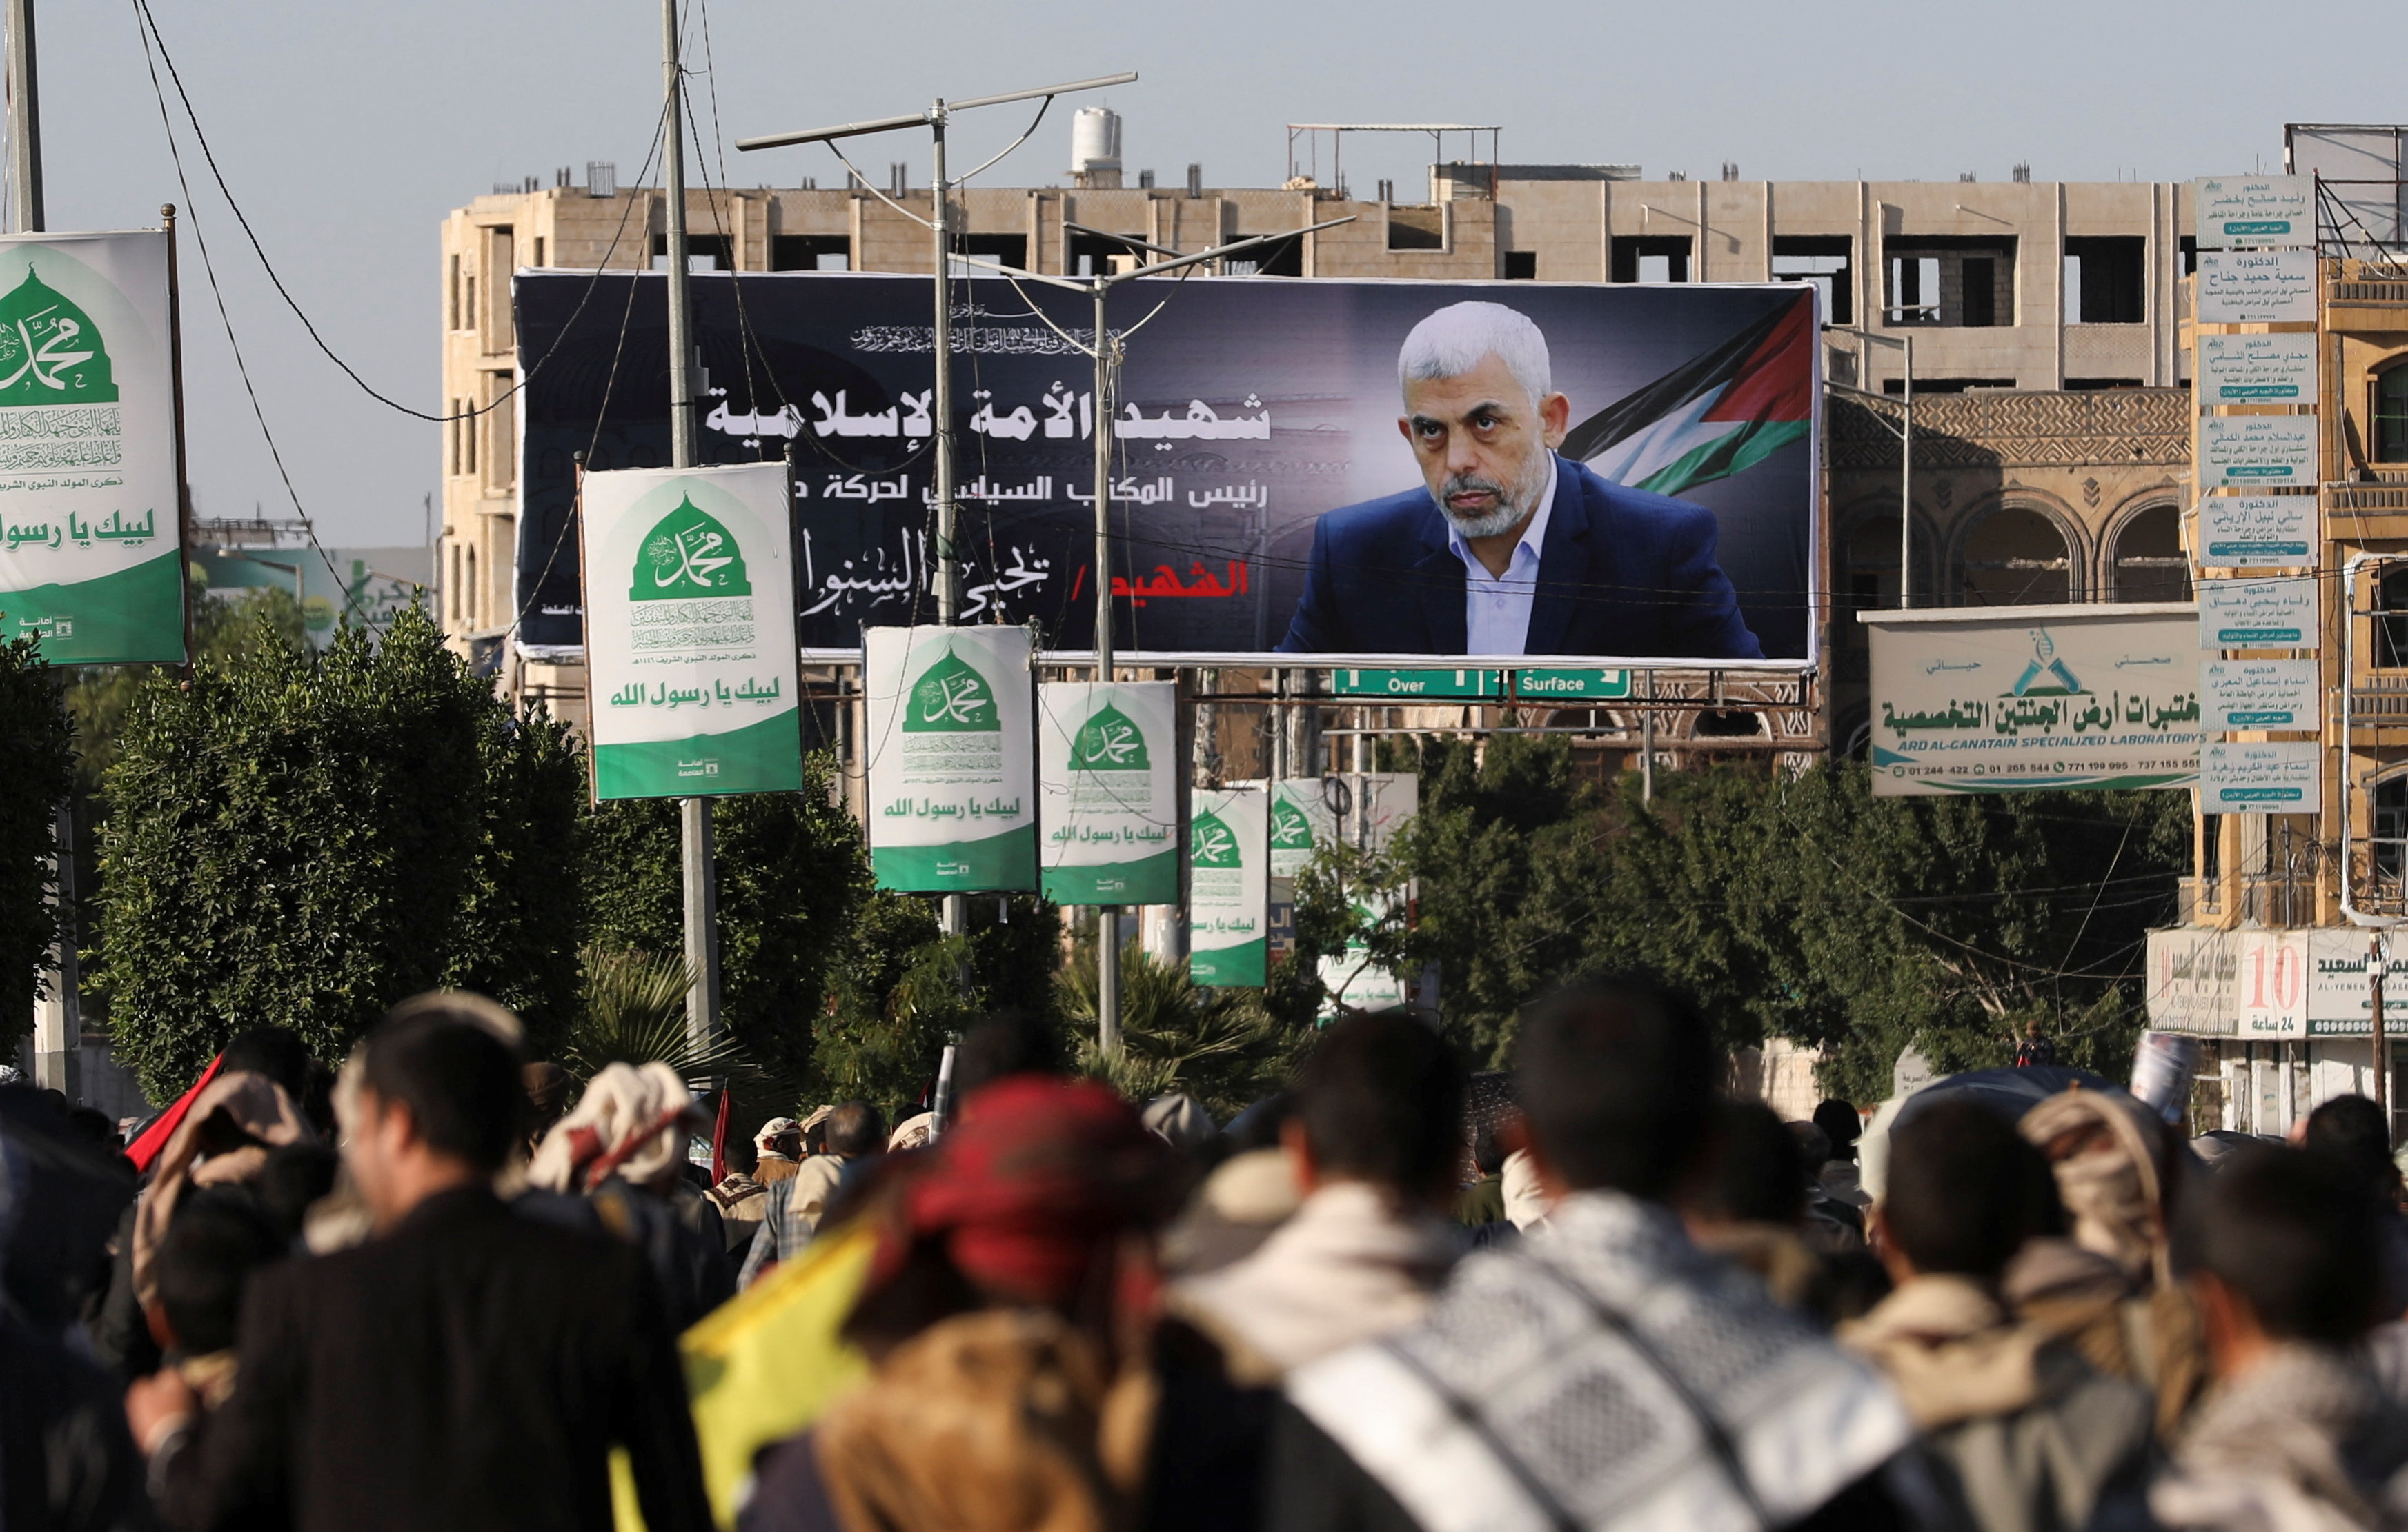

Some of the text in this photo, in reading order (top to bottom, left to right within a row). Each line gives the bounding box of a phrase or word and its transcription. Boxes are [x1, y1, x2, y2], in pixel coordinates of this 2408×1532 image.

[2247, 194, 2277, 207] صالح
[2281, 192, 2306, 204] وليد
[2236, 257, 2278, 268] الدكتورة
[2209, 268, 2305, 286] سمية حميد جناح
[2245, 340, 2271, 350] الدكتور
[705, 380, 1271, 452] شهيد الأمة لإسلامية
[2245, 423, 2272, 432] الدكتور
[0, 476, 123, 491] ذكرى المولد النبوي الشري
[823, 474, 908, 504] لحركة
[1188, 479, 1268, 508] رئيس
[2239, 499, 2278, 510] الدكتورة
[2255, 511, 2275, 524] نبيل
[69, 510, 92, 546] يا
[94, 508, 155, 545] لبيك
[655, 521, 734, 588] محمد
[800, 526, 928, 617] السنوا
[1111, 559, 1248, 608] الشهيد
[2243, 586, 2276, 595] الدكتورة
[655, 655, 682, 664] الشريف
[684, 655, 707, 664] النبوي
[709, 653, 730, 662] المولد
[731, 653, 756, 661] ذكرى
[1926, 659, 1982, 675] حياتي
[2243, 667, 2276, 676] الدكتورة
[1388, 677, 1425, 693] Over
[1523, 676, 1585, 691] Surface
[611, 675, 780, 709] لبيك يا رسول الله
[923, 670, 987, 724] محمد
[1882, 690, 2200, 738] ختبرات أرض الجنتين التخصصية
[1085, 719, 1139, 764] محمد
[1898, 733, 2207, 752] ARD AL-GANATAIN SPECIALIZED LABORATORYS
[2244, 750, 2277, 761] الدكتورة
[1909, 767, 1921, 775] 01
[1989, 764, 2001, 773] 01
[2068, 763, 2085, 771] 771
[2138, 761, 2156, 769] 737
[884, 797, 1020, 819] لبيك يا رسول الله
[1052, 825, 1168, 845] لبيك يا رسول الله
[1216, 917, 1227, 934] يا
[1228, 917, 1255, 934] لبيك
[2247, 944, 2300, 1011] 10
[2251, 1015, 2295, 1031] 24 ساعة
